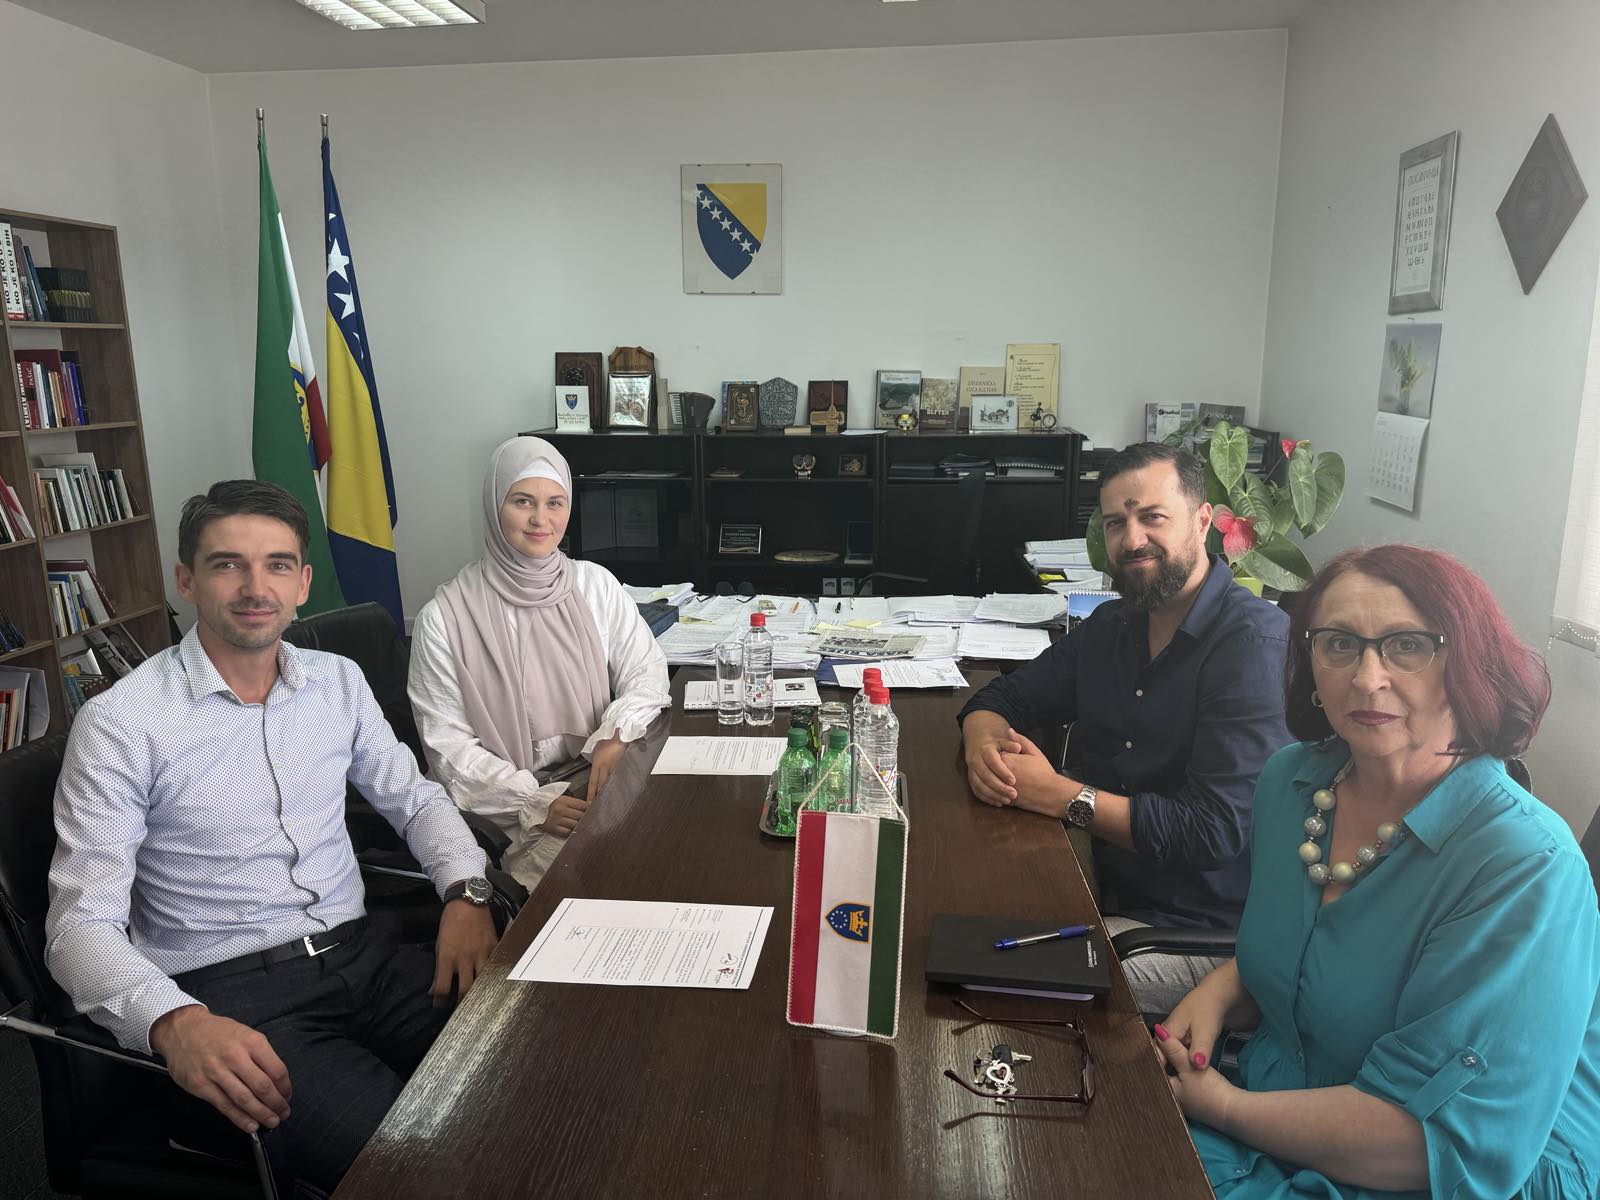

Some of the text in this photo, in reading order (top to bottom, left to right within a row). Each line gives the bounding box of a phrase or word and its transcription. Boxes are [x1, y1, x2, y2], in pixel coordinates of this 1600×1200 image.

[9, 260, 15, 273] KO
[12, 277, 17, 288] JE
[4, 290, 10, 304] KO
[14, 291, 20, 304] KO
